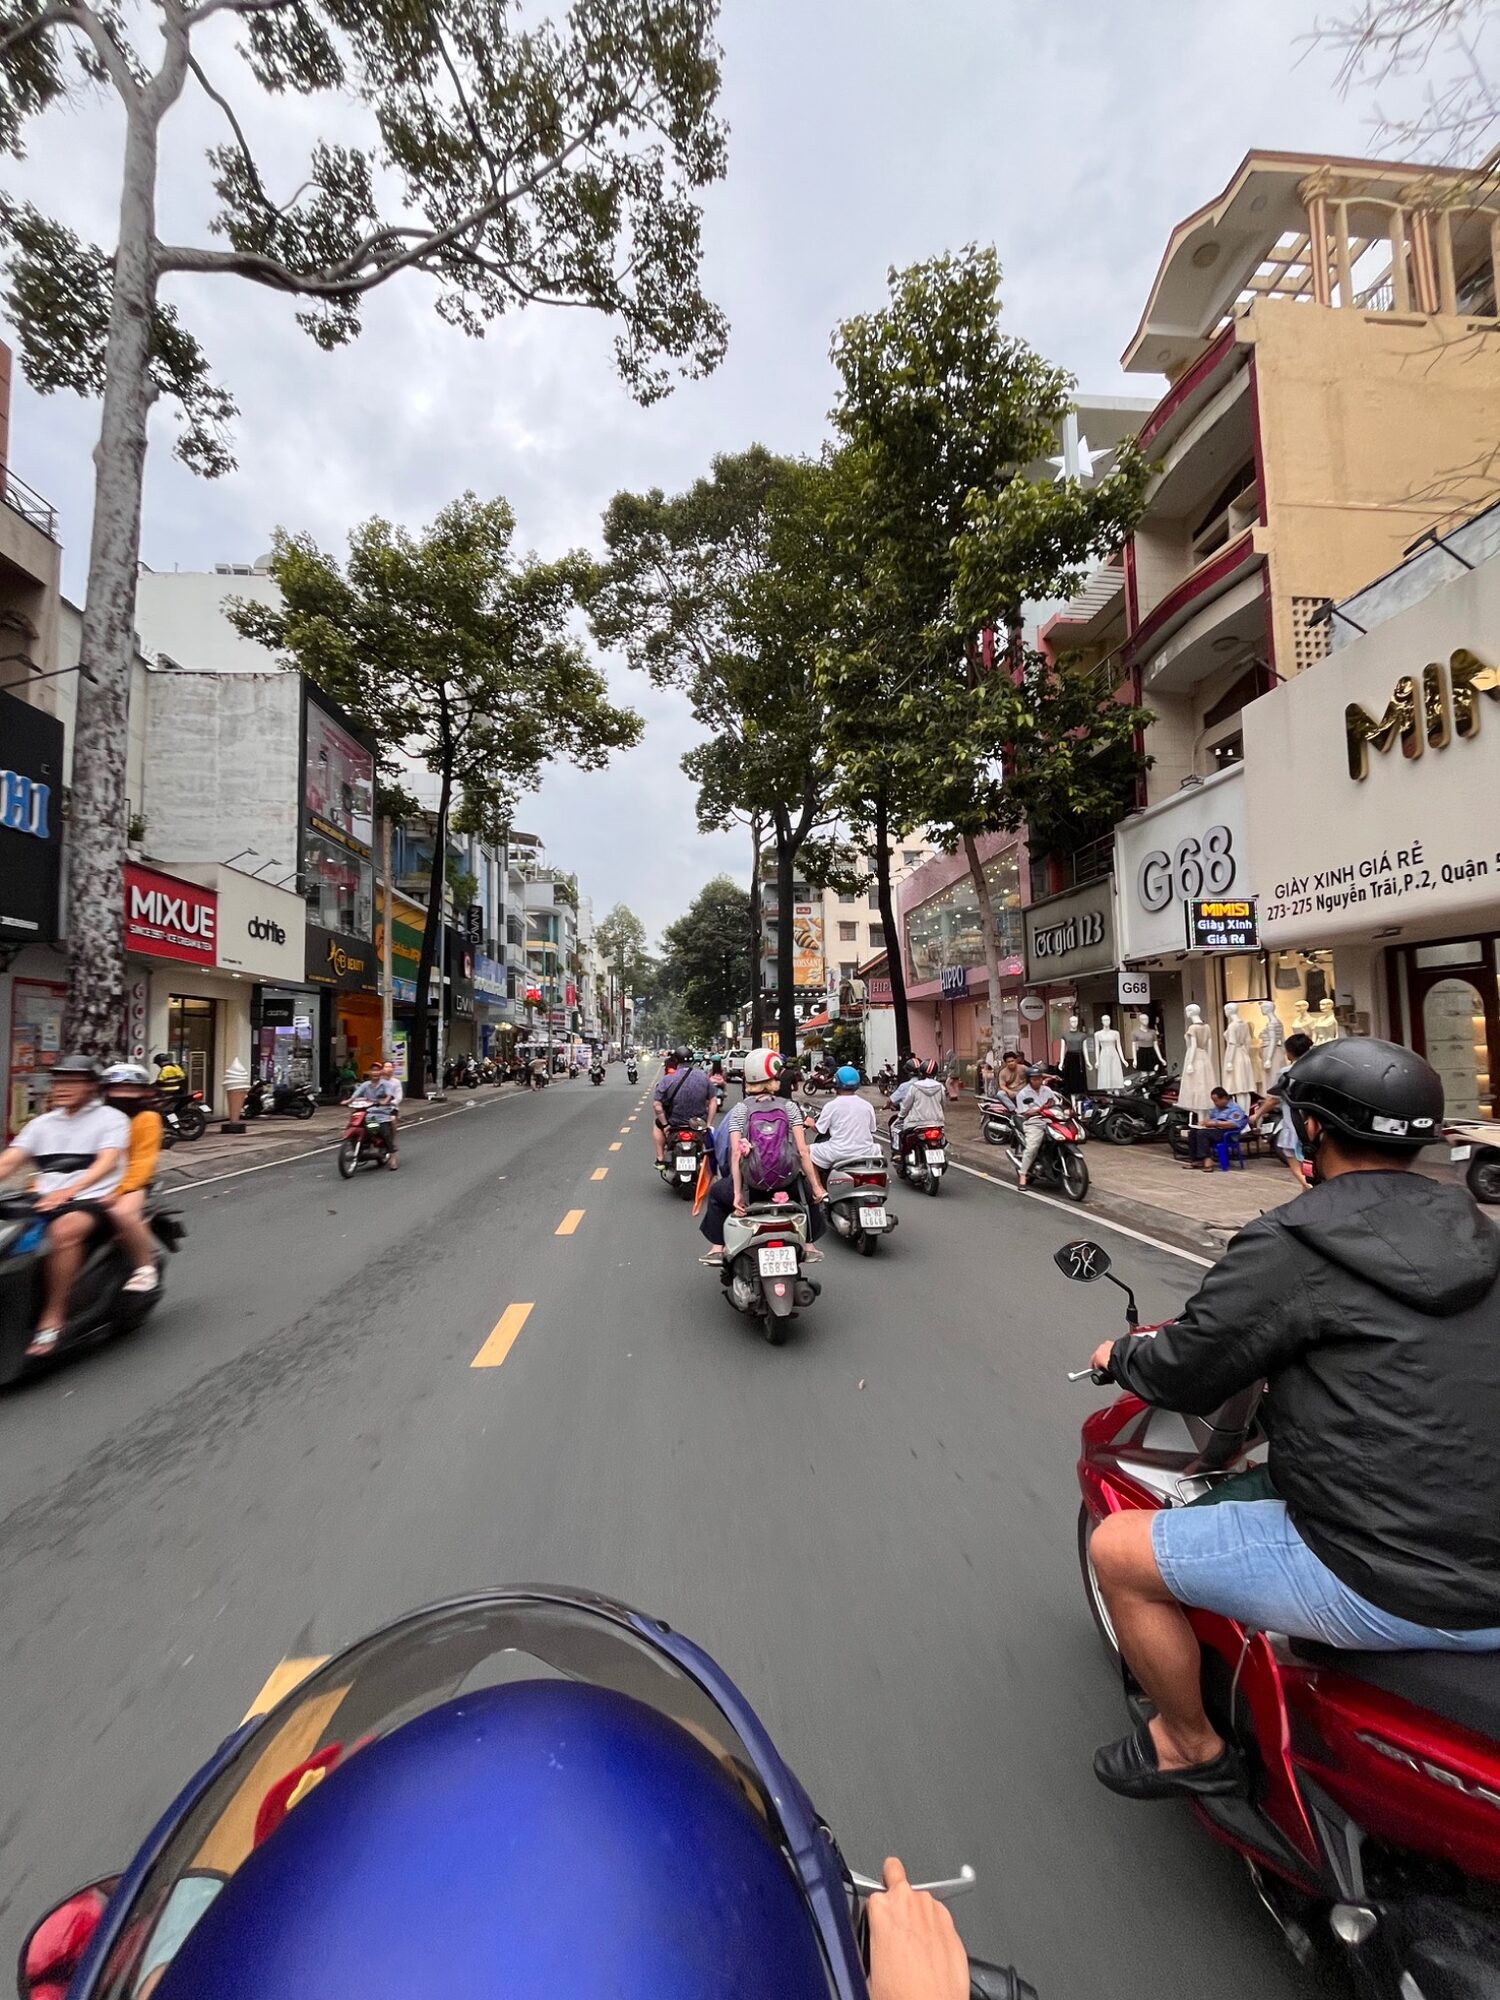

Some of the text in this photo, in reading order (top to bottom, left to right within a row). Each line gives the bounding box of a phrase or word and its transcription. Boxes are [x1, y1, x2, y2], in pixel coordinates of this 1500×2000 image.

[1138, 825, 1235, 912] G68
[1274, 840, 1424, 900] GIÀY XINH GIÁ RẺ
[1267, 898, 1312, 921] 273-275
[1316, 883, 1367, 914] Nguyễn
[1441, 859, 1488, 884] Quận
[131, 885, 215, 938] MIXUE
[1201, 903, 1249, 917] MIMISI
[1227, 919, 1253, 930] Xinh
[1079, 912, 1104, 946] 123
[1207, 934, 1228, 945] Giá
[939, 964, 964, 992] HIPPO
[1122, 982, 1148, 994] G68
